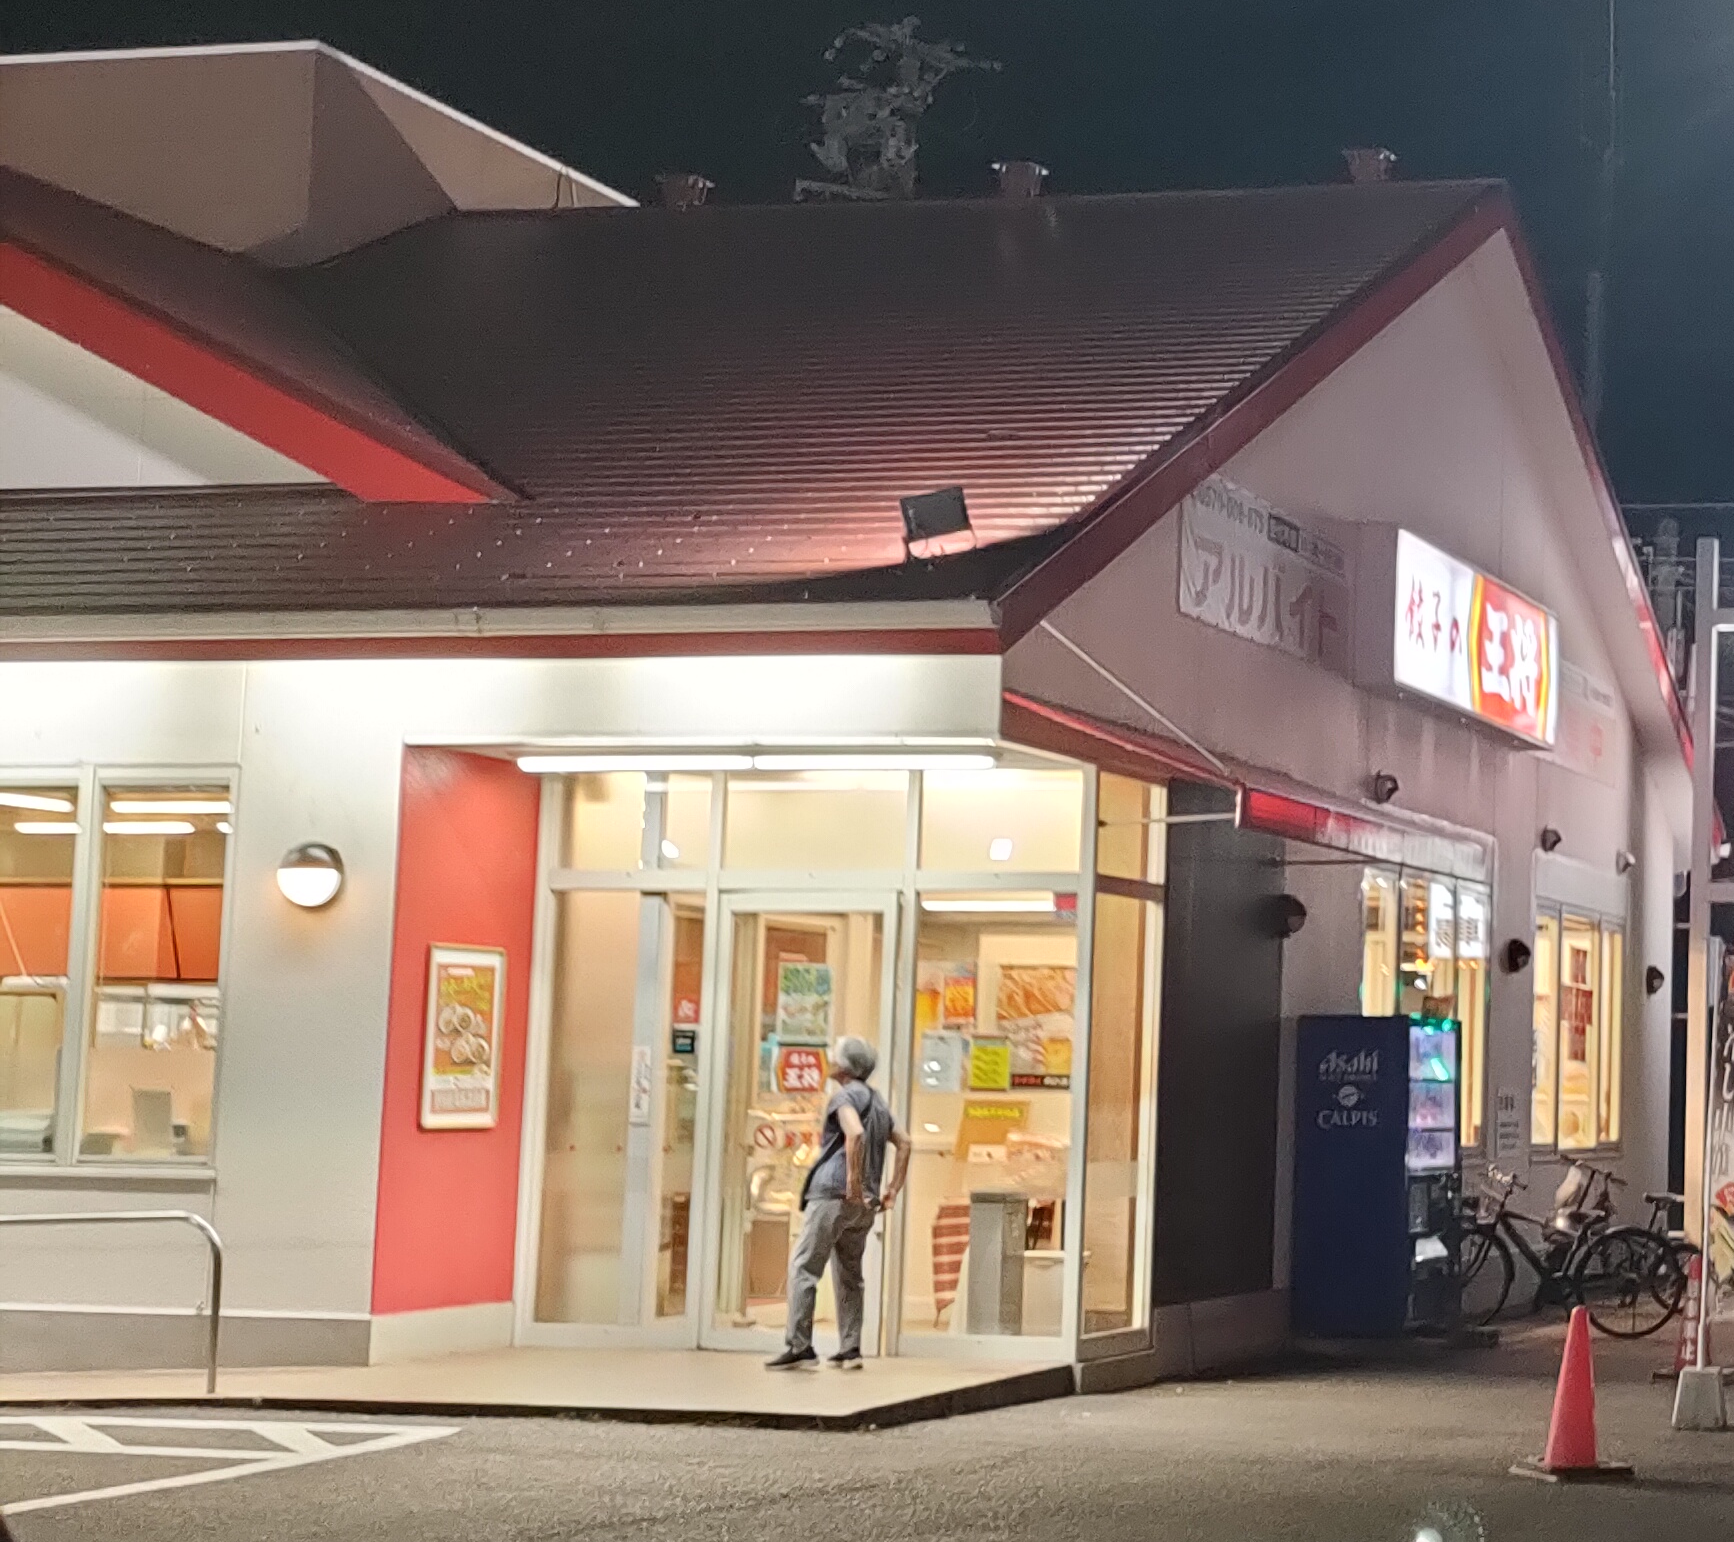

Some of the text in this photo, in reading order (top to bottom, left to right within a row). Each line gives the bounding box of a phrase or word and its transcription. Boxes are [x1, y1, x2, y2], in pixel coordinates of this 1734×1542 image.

[1405, 574, 1462, 655] 餃子の
[1481, 601, 1539, 718] 王将
